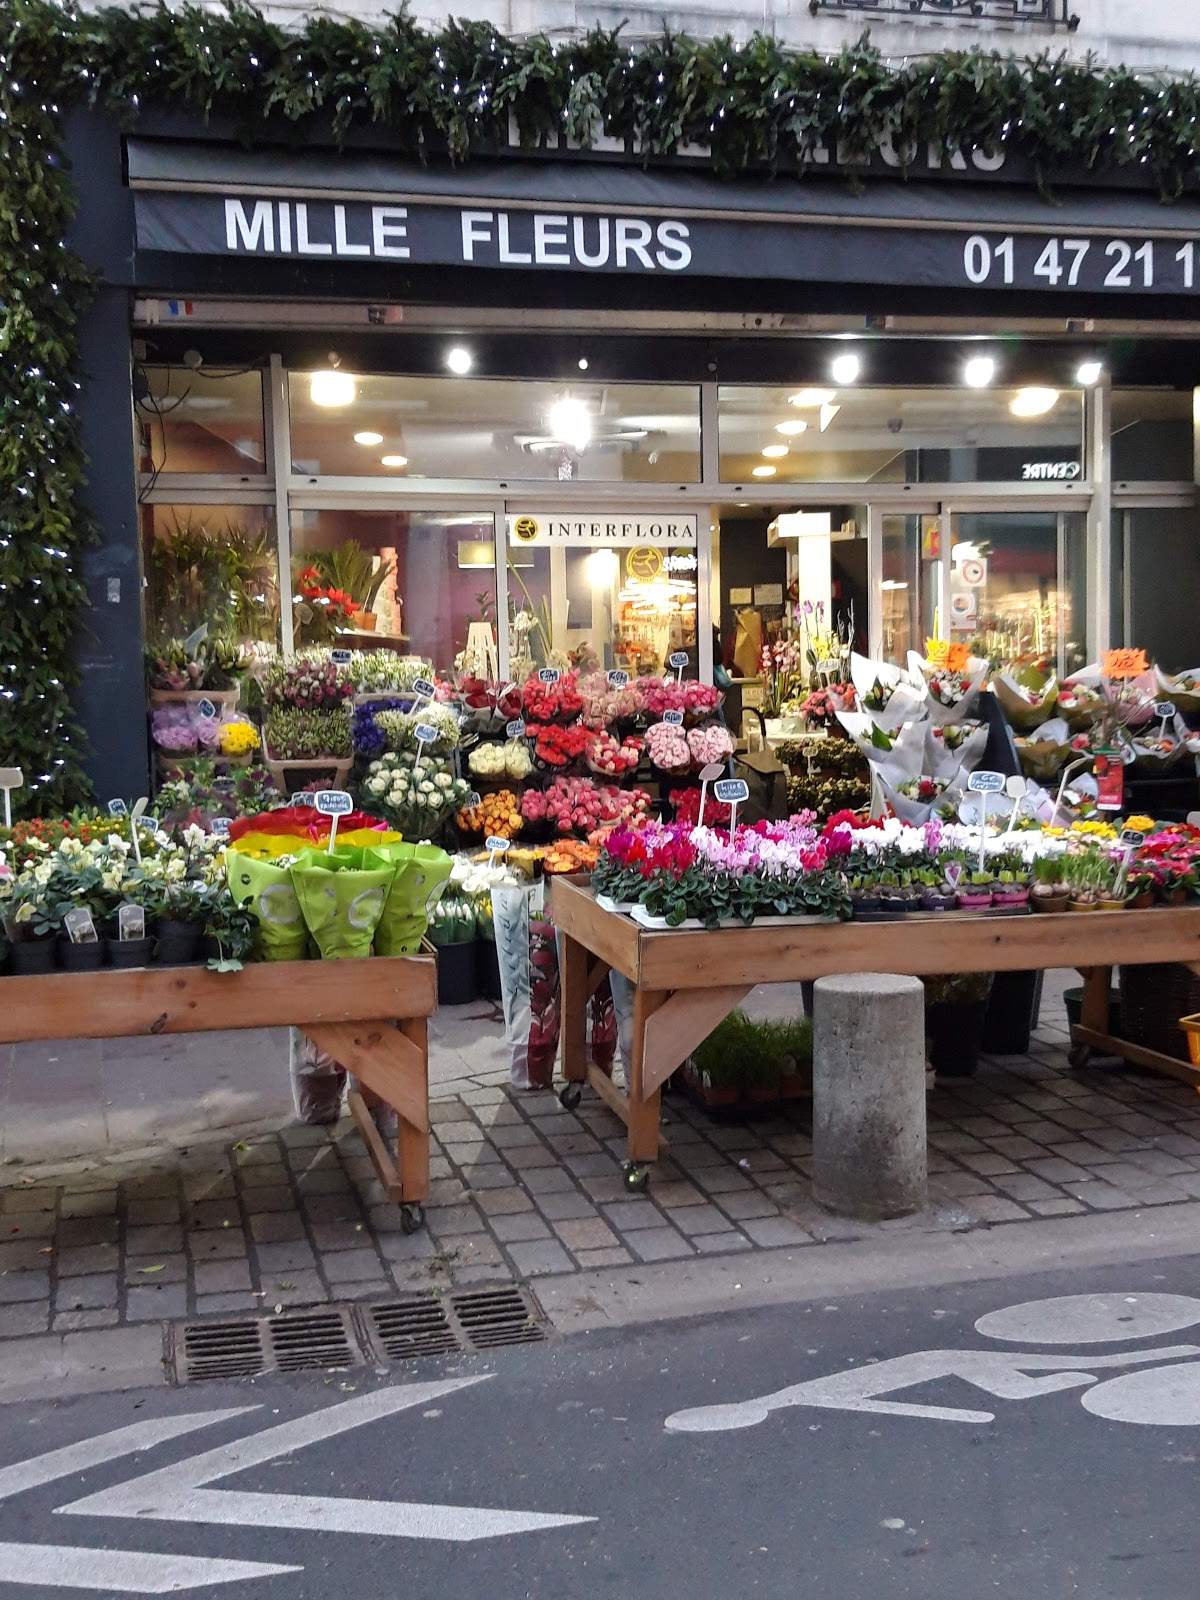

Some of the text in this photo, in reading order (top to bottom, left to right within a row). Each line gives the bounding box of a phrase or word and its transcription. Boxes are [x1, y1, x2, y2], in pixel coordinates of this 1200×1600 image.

[224, 199, 692, 271] MILLE FLEURS
[964, 236, 1014, 285] 01
[1033, 239, 1090, 287] 47
[1103, 241, 1154, 288] 21
[547, 522, 694, 539] INTERFLORA
